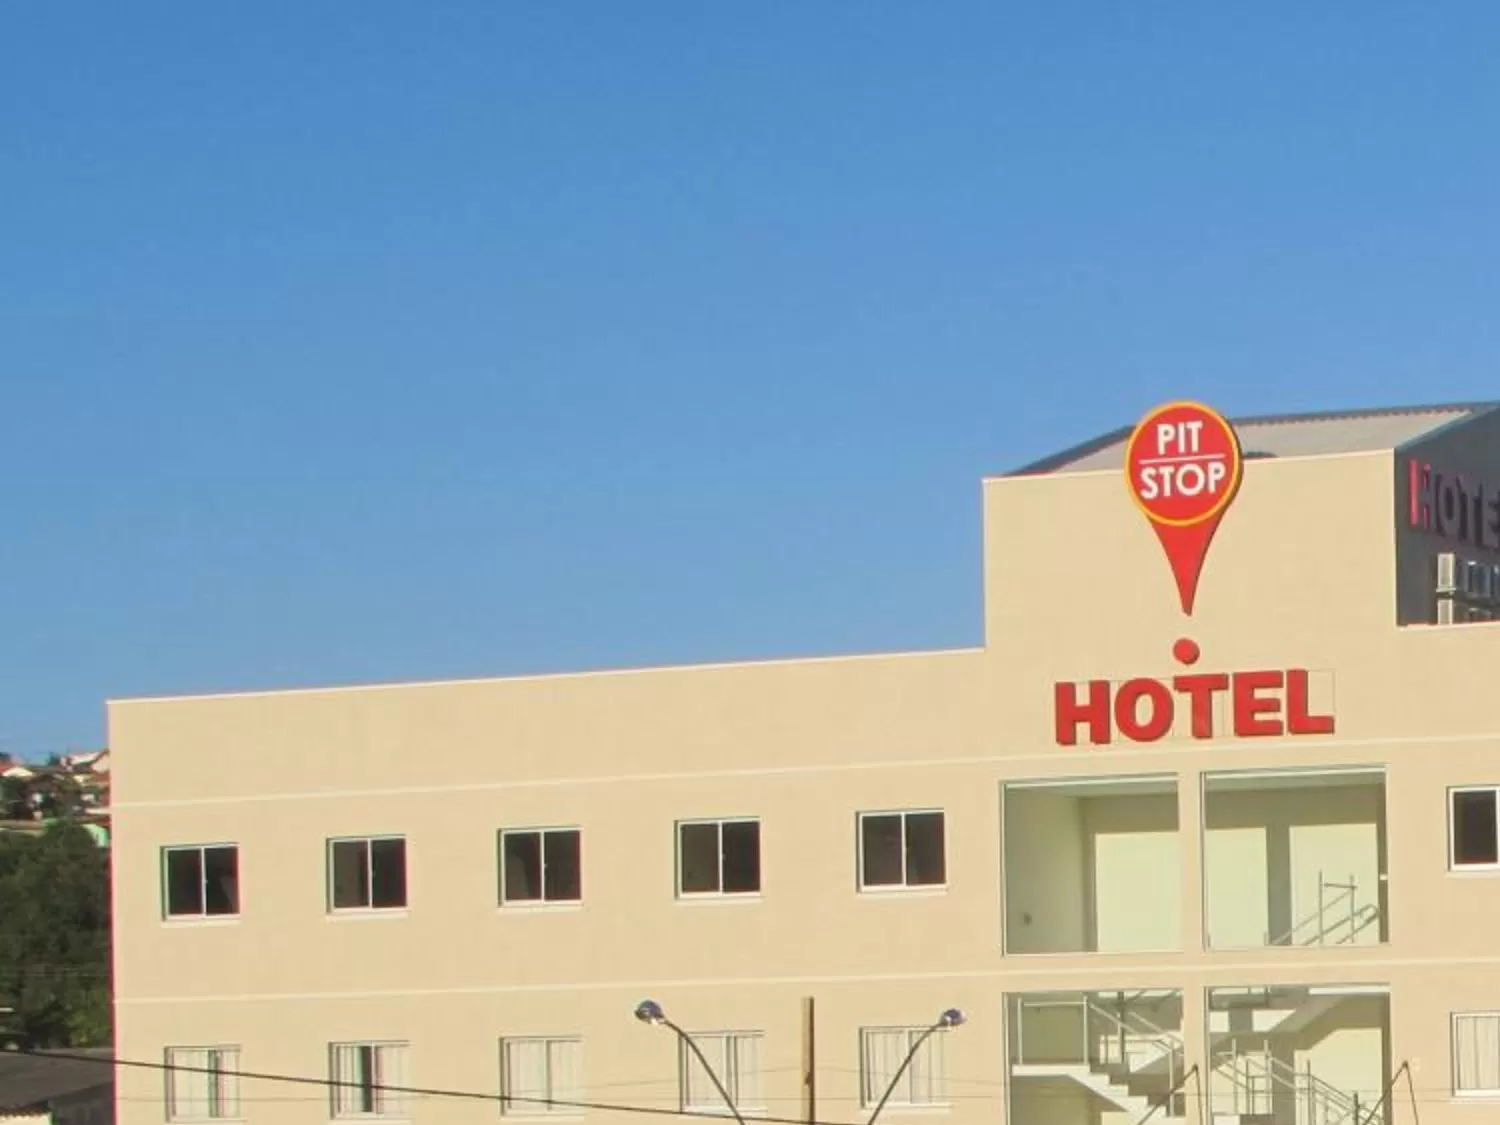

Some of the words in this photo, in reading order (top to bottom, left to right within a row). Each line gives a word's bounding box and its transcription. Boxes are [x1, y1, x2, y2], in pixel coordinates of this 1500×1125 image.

[1156, 420, 1203, 455] PIT
[1140, 461, 1226, 499] STOP
[1055, 669, 1335, 746] HOTEL
